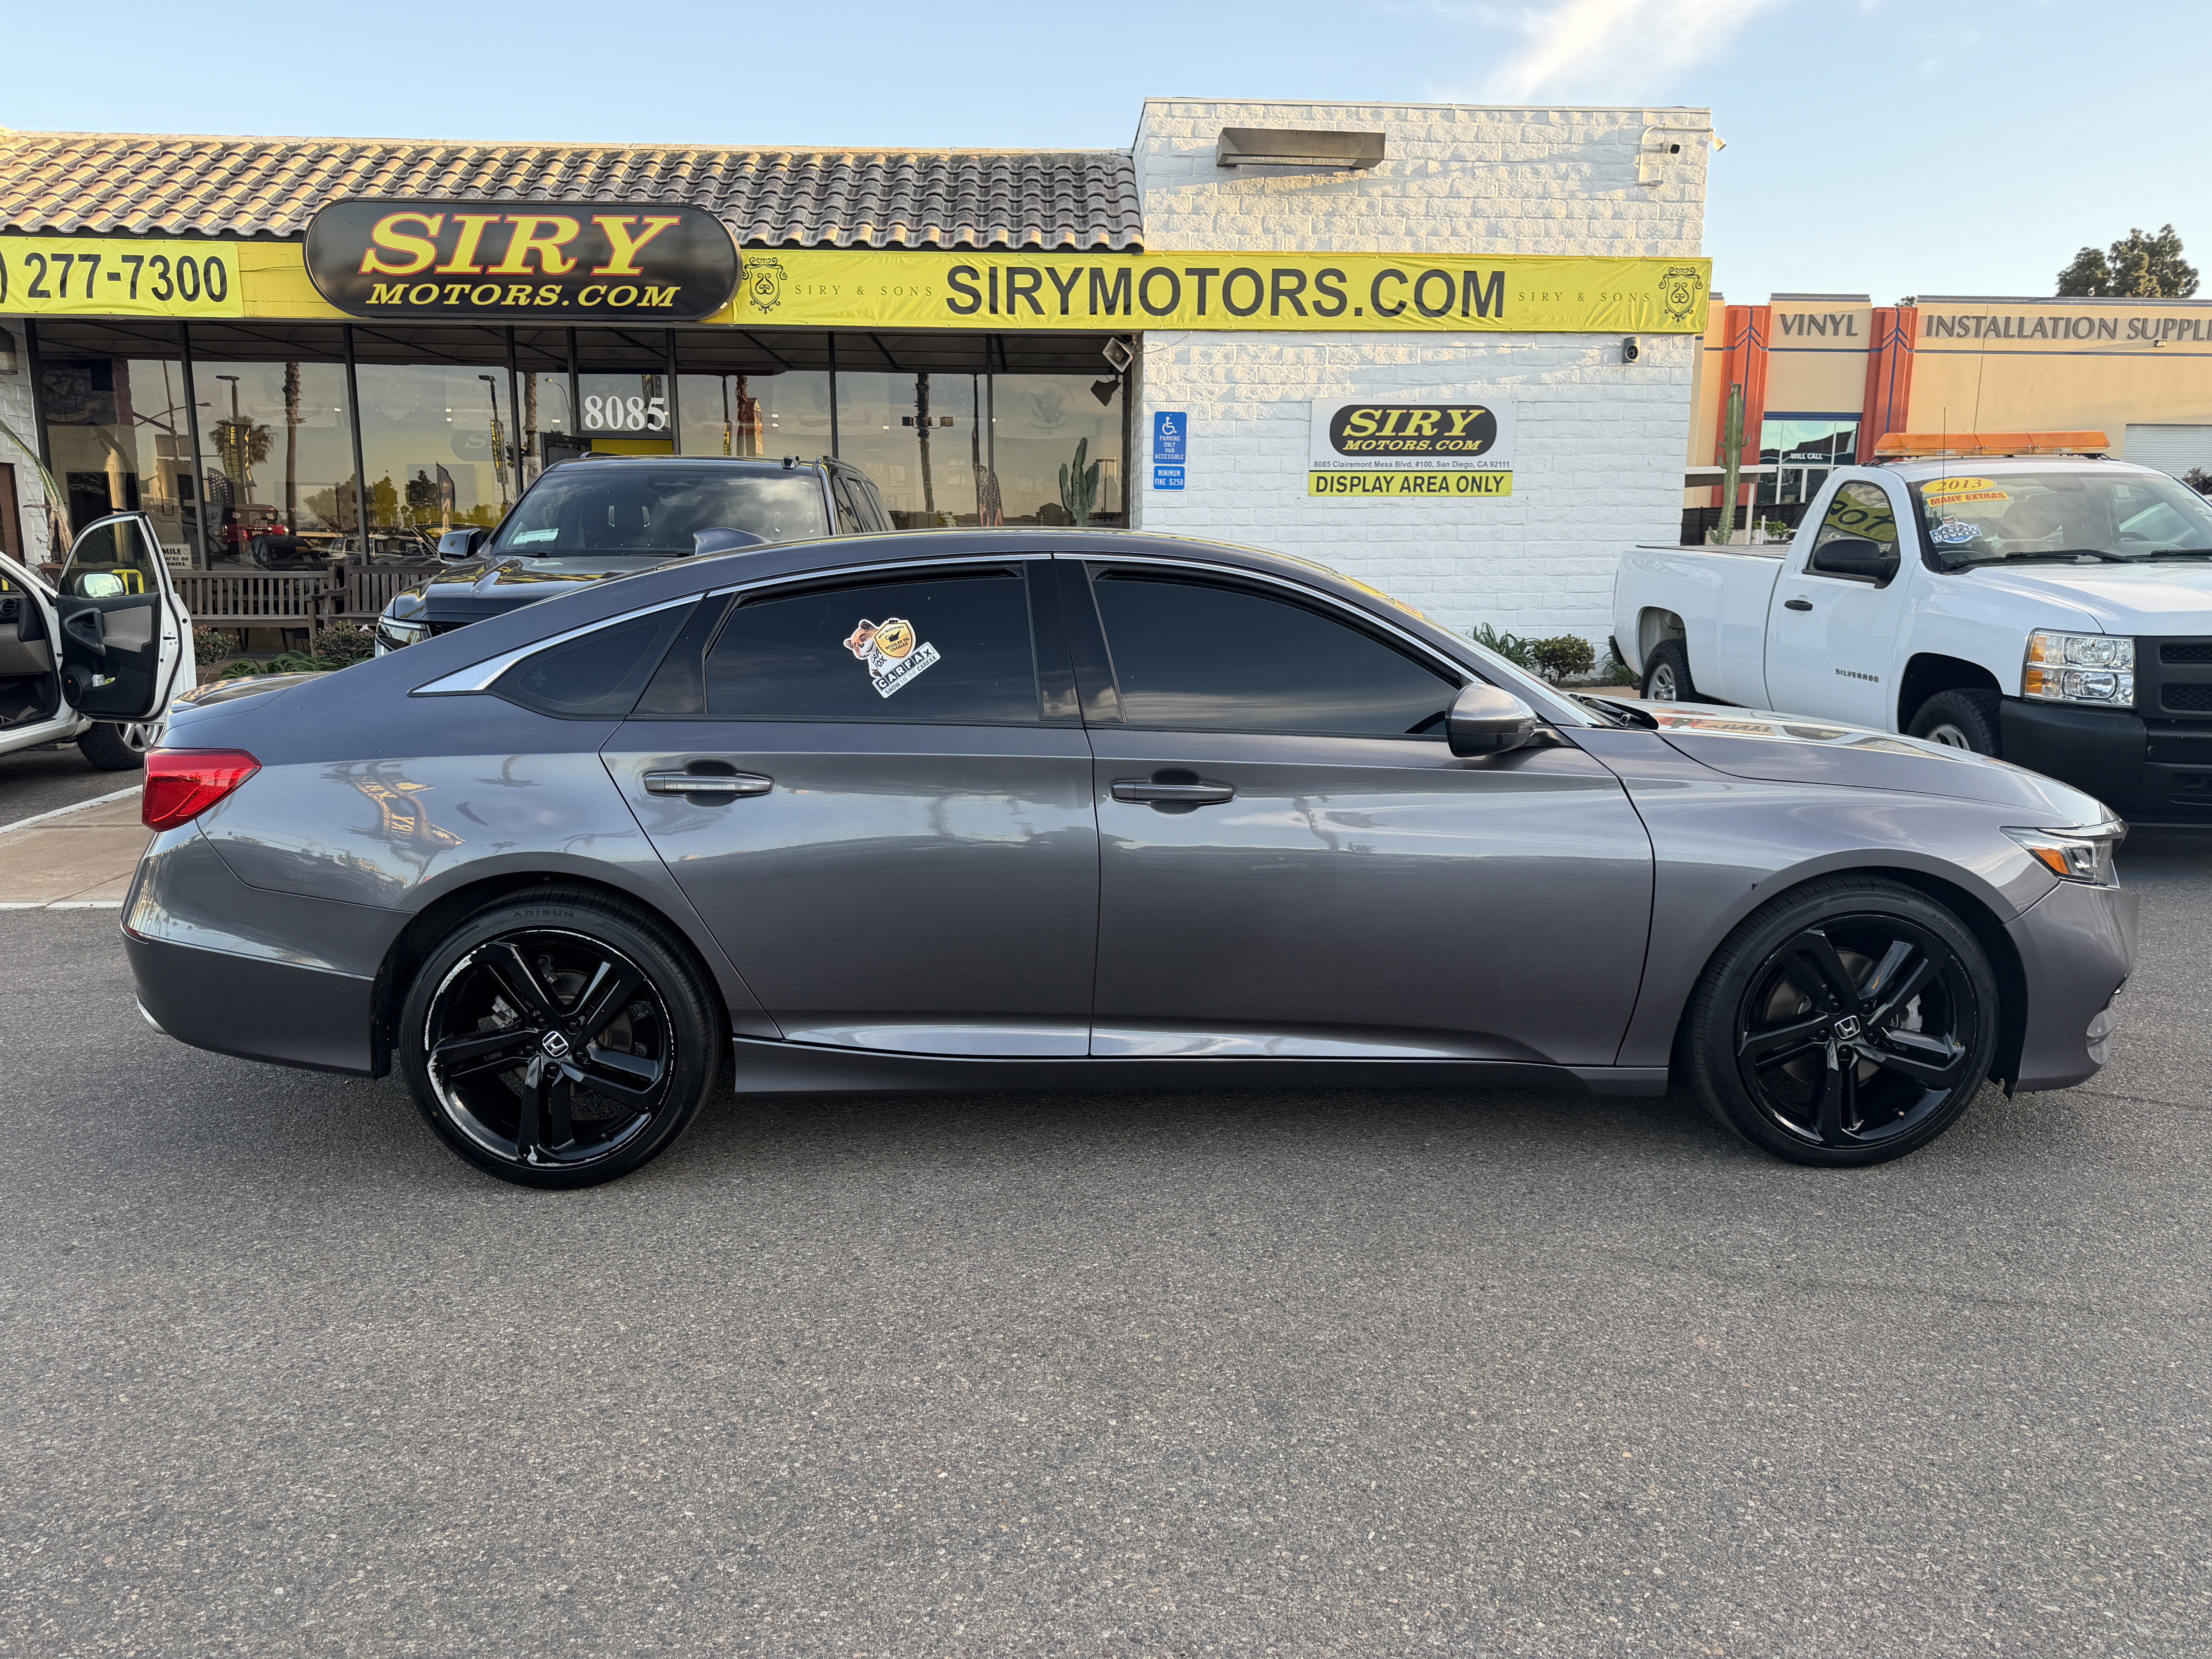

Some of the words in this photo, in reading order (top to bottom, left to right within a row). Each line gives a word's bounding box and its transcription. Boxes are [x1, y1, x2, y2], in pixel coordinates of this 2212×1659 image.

[358, 212, 681, 276] SIRY
[24, 252, 227, 302] 277-7300
[366, 283, 680, 307] MOTORS.COM
[795, 285, 841, 295] SIRY
[857, 286, 865, 295] &
[881, 286, 932, 296] SONS
[946, 265, 1505, 318] SIRYMOTORS.COM
[1518, 292, 1563, 301] SIRY
[1577, 292, 1585, 302] &
[1601, 293, 1650, 302] SONS
[1780, 313, 1858, 336] VINYL
[1926, 315, 2120, 340] INSTALLATION
[585, 396, 666, 430] 8085
[1342, 409, 1486, 437] SIRY
[1342, 440, 1483, 451] MOTORS.COM
[1316, 476, 1395, 493] DISPLAY
[1399, 476, 1450, 493] AREA
[1456, 475, 1505, 493] ONLY
[1936, 479, 1982, 491] 2013
[1930, 495, 1963, 505] MANY
[1965, 492, 2006, 501] EXTRAS
[871, 648, 882, 664] CAR
[875, 655, 888, 670] FOX
[876, 648, 933, 690] CARFAX
[885, 681, 901, 695] SHOW
[908, 669, 918, 679] THE
[917, 655, 937, 671] CARFAX
[1836, 668, 1879, 683] SILVERADO
[512, 910, 574, 918] ARISUN
